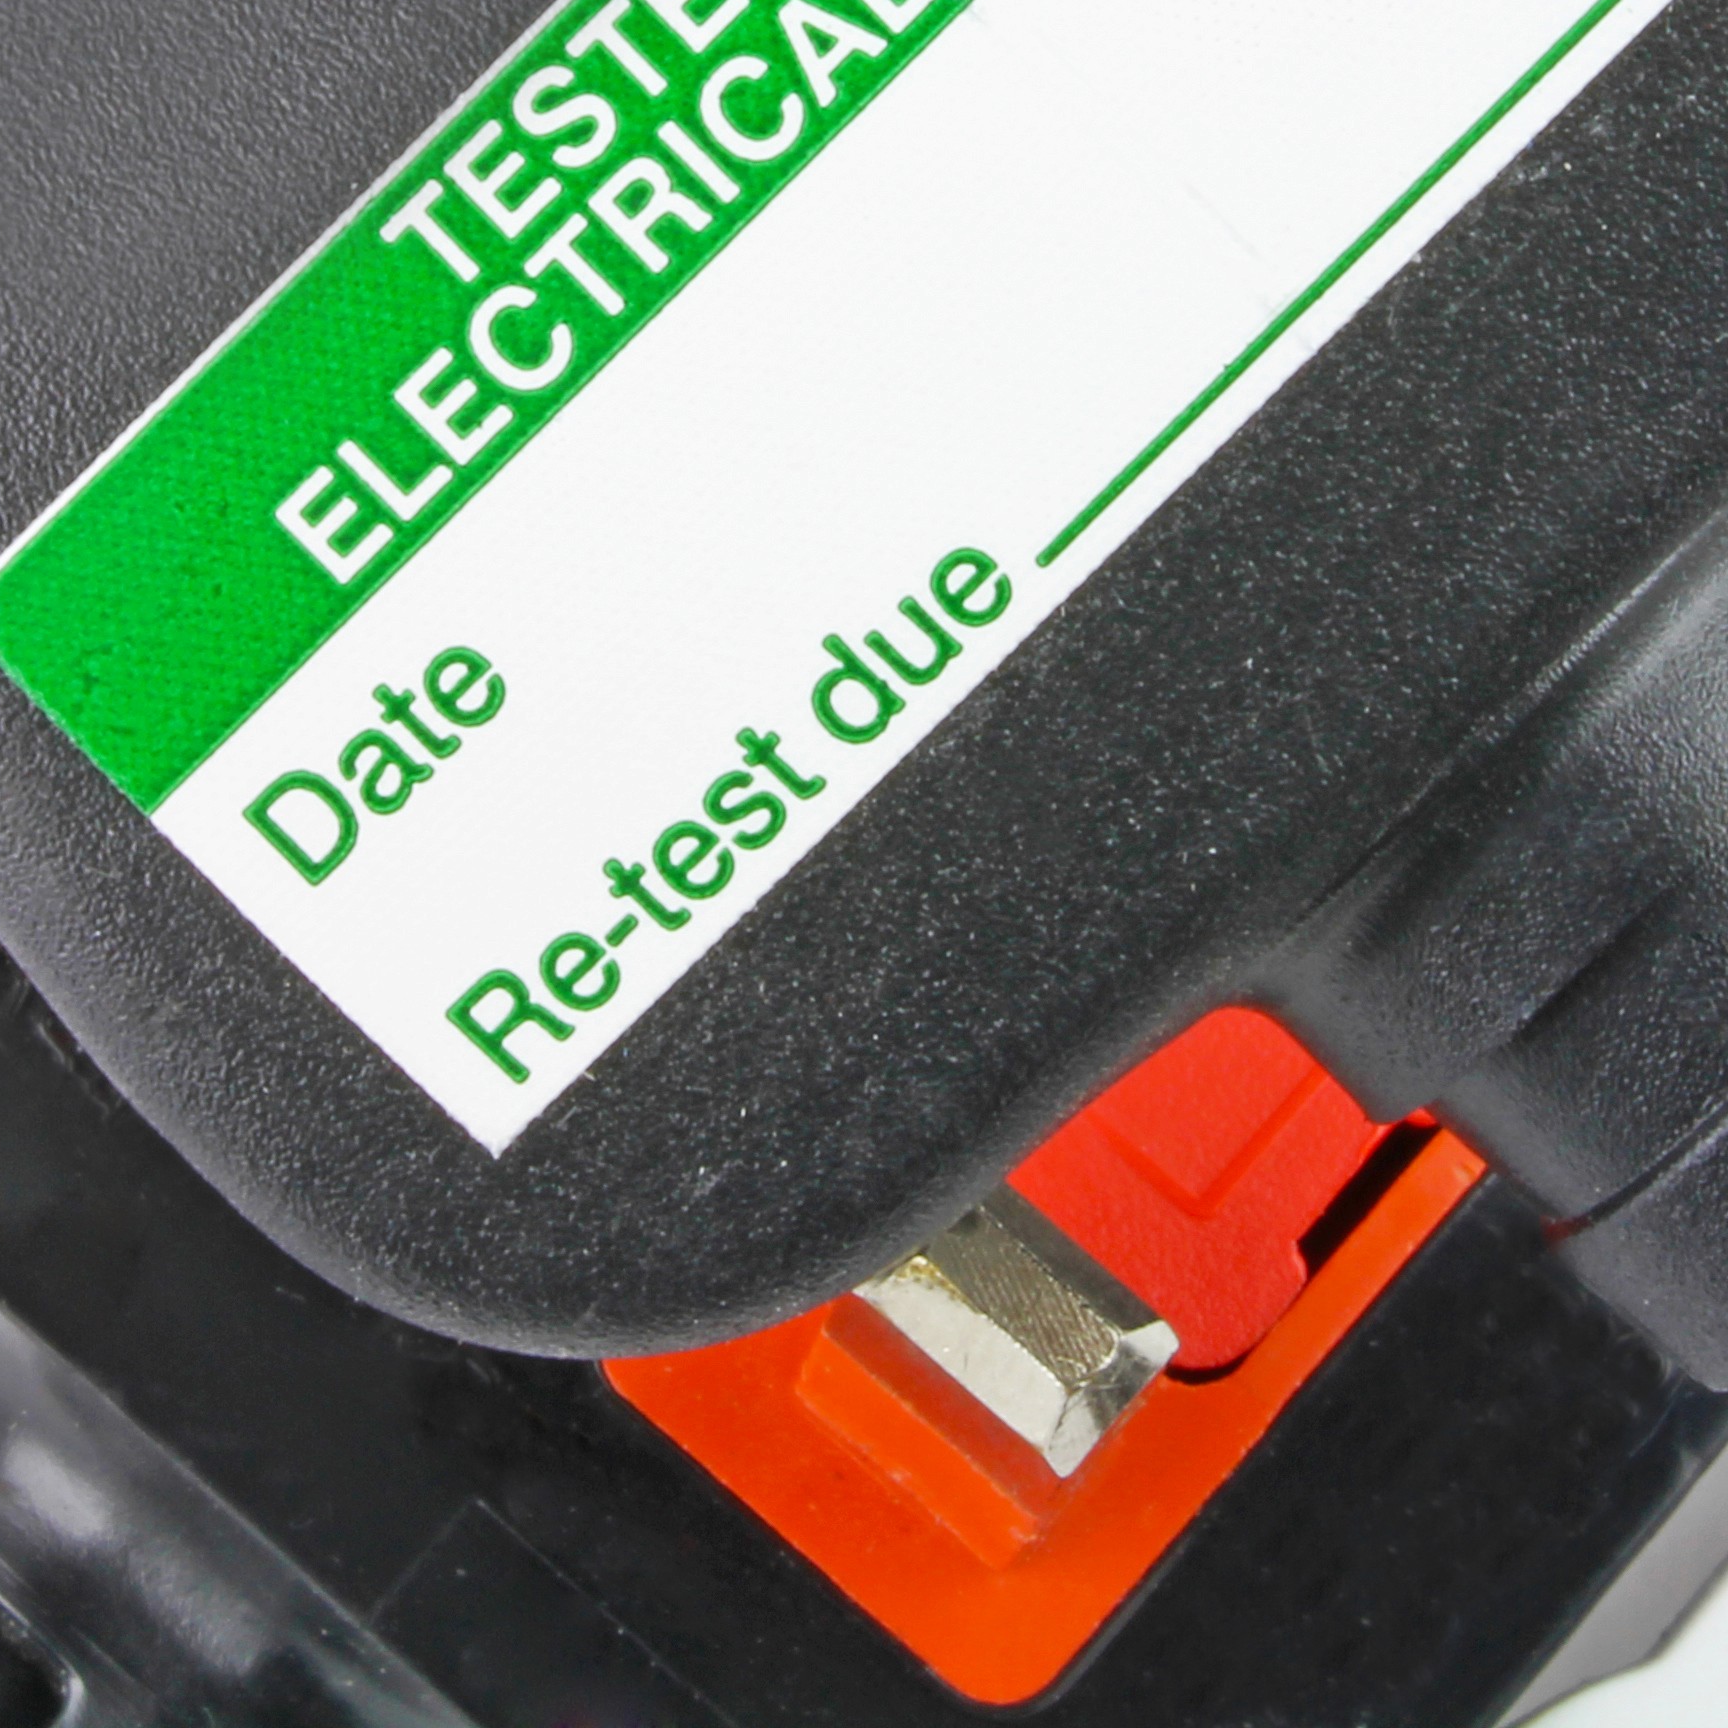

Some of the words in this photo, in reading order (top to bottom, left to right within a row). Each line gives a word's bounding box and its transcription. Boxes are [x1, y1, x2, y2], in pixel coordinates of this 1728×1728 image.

[242, 647, 506, 887] Date
[445, 728, 827, 1084] Re-test
[811, 547, 1012, 745] due
